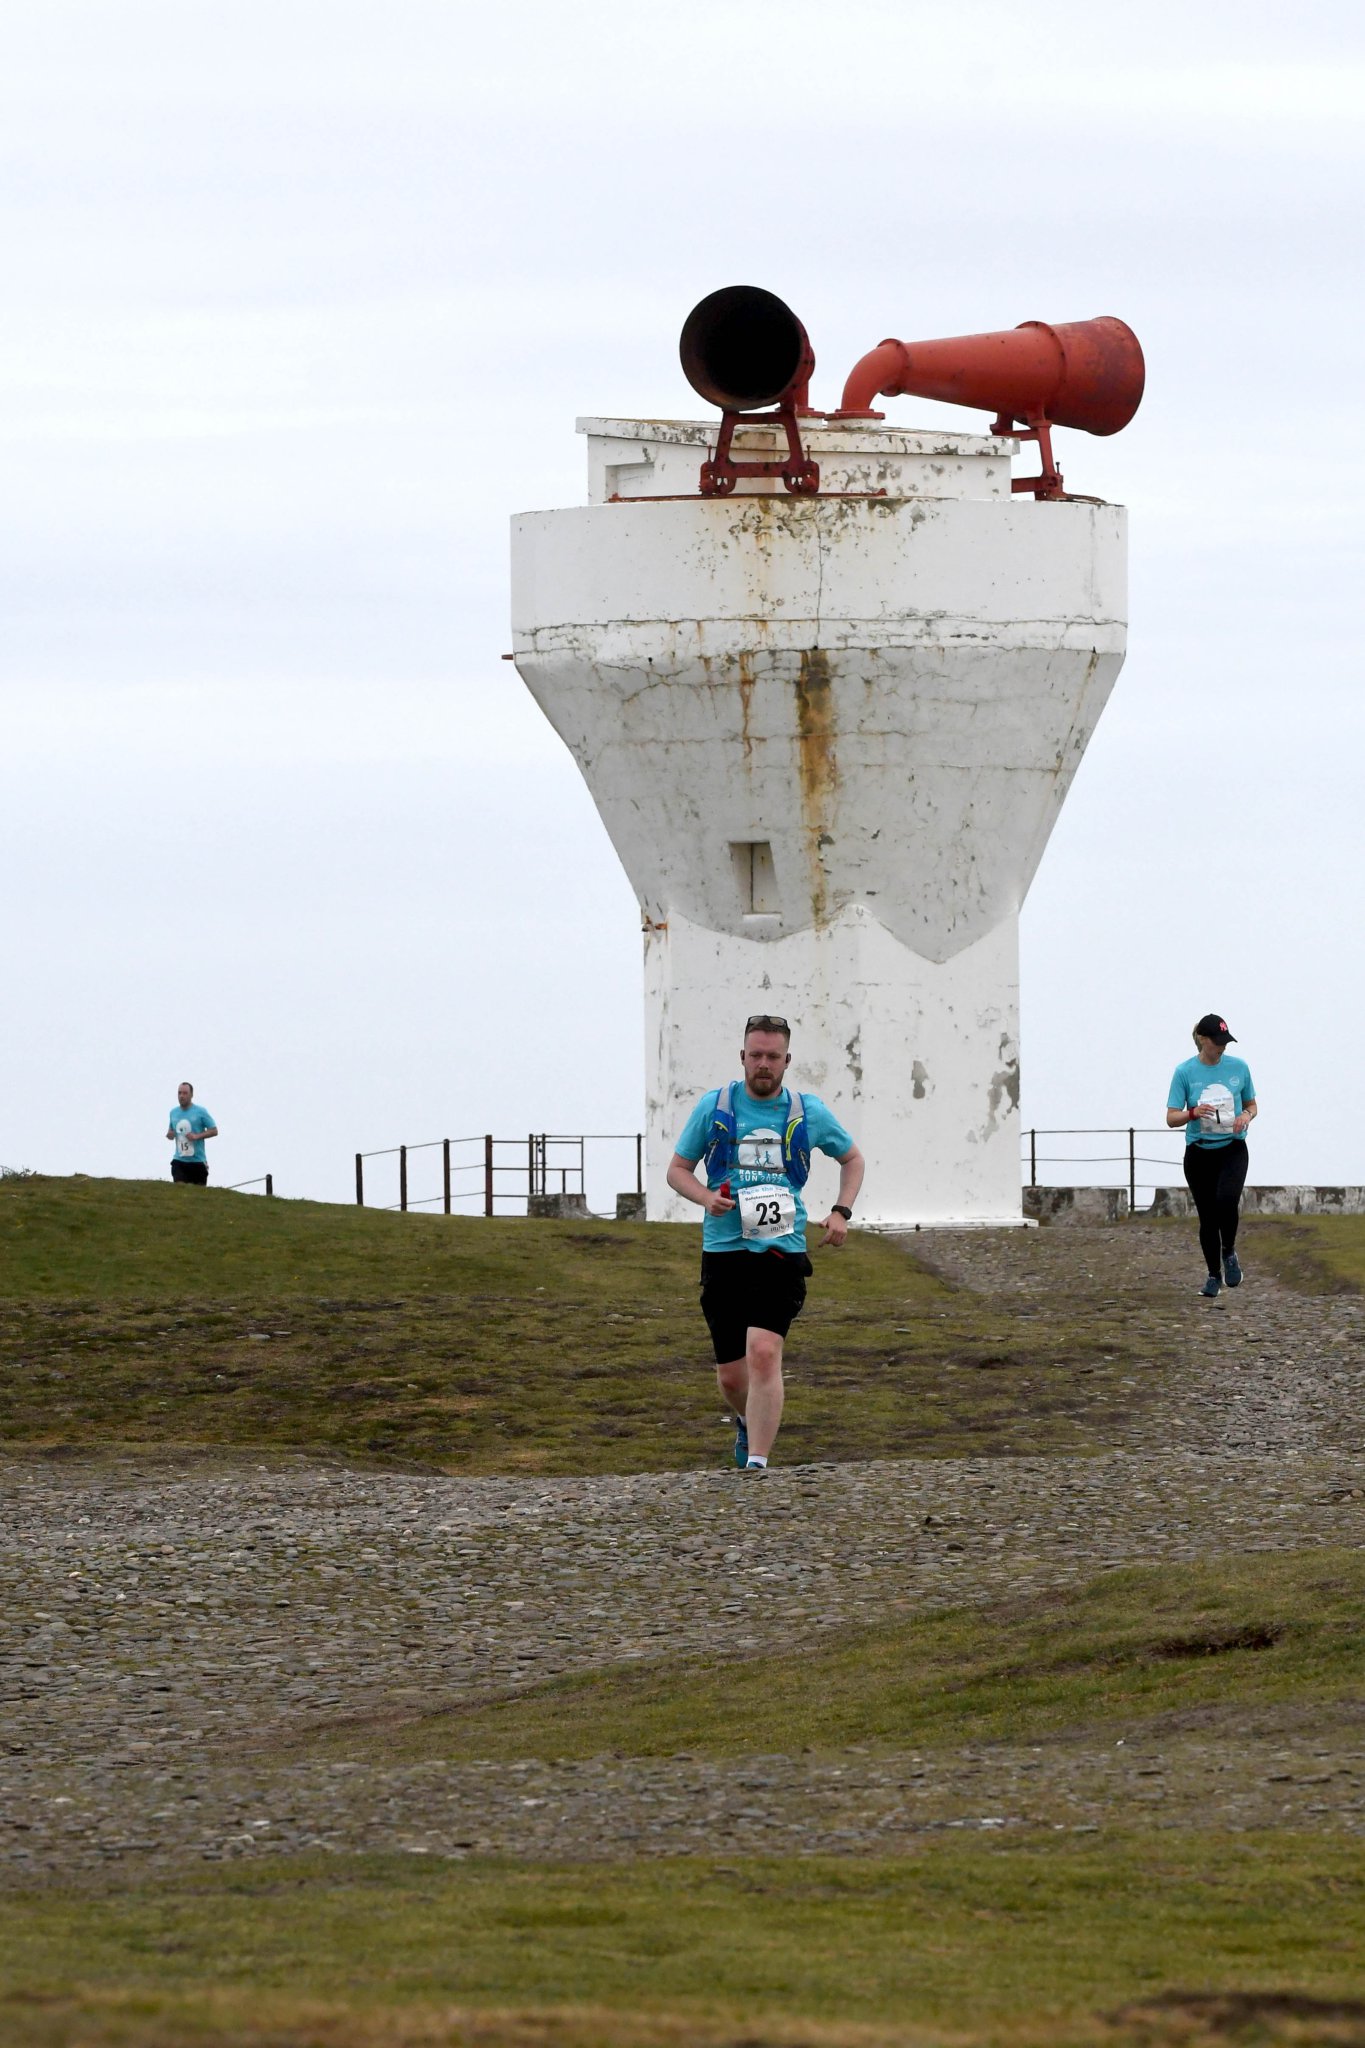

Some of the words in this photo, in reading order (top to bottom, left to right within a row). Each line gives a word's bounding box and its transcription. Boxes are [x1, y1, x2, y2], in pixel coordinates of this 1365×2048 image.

[1215, 1109, 1221, 1124] 1
[180, 1142, 189, 1152] 15
[740, 1174, 758, 1182] SUN
[760, 1175, 782, 1184] 2022
[755, 1201, 782, 1226] 23
